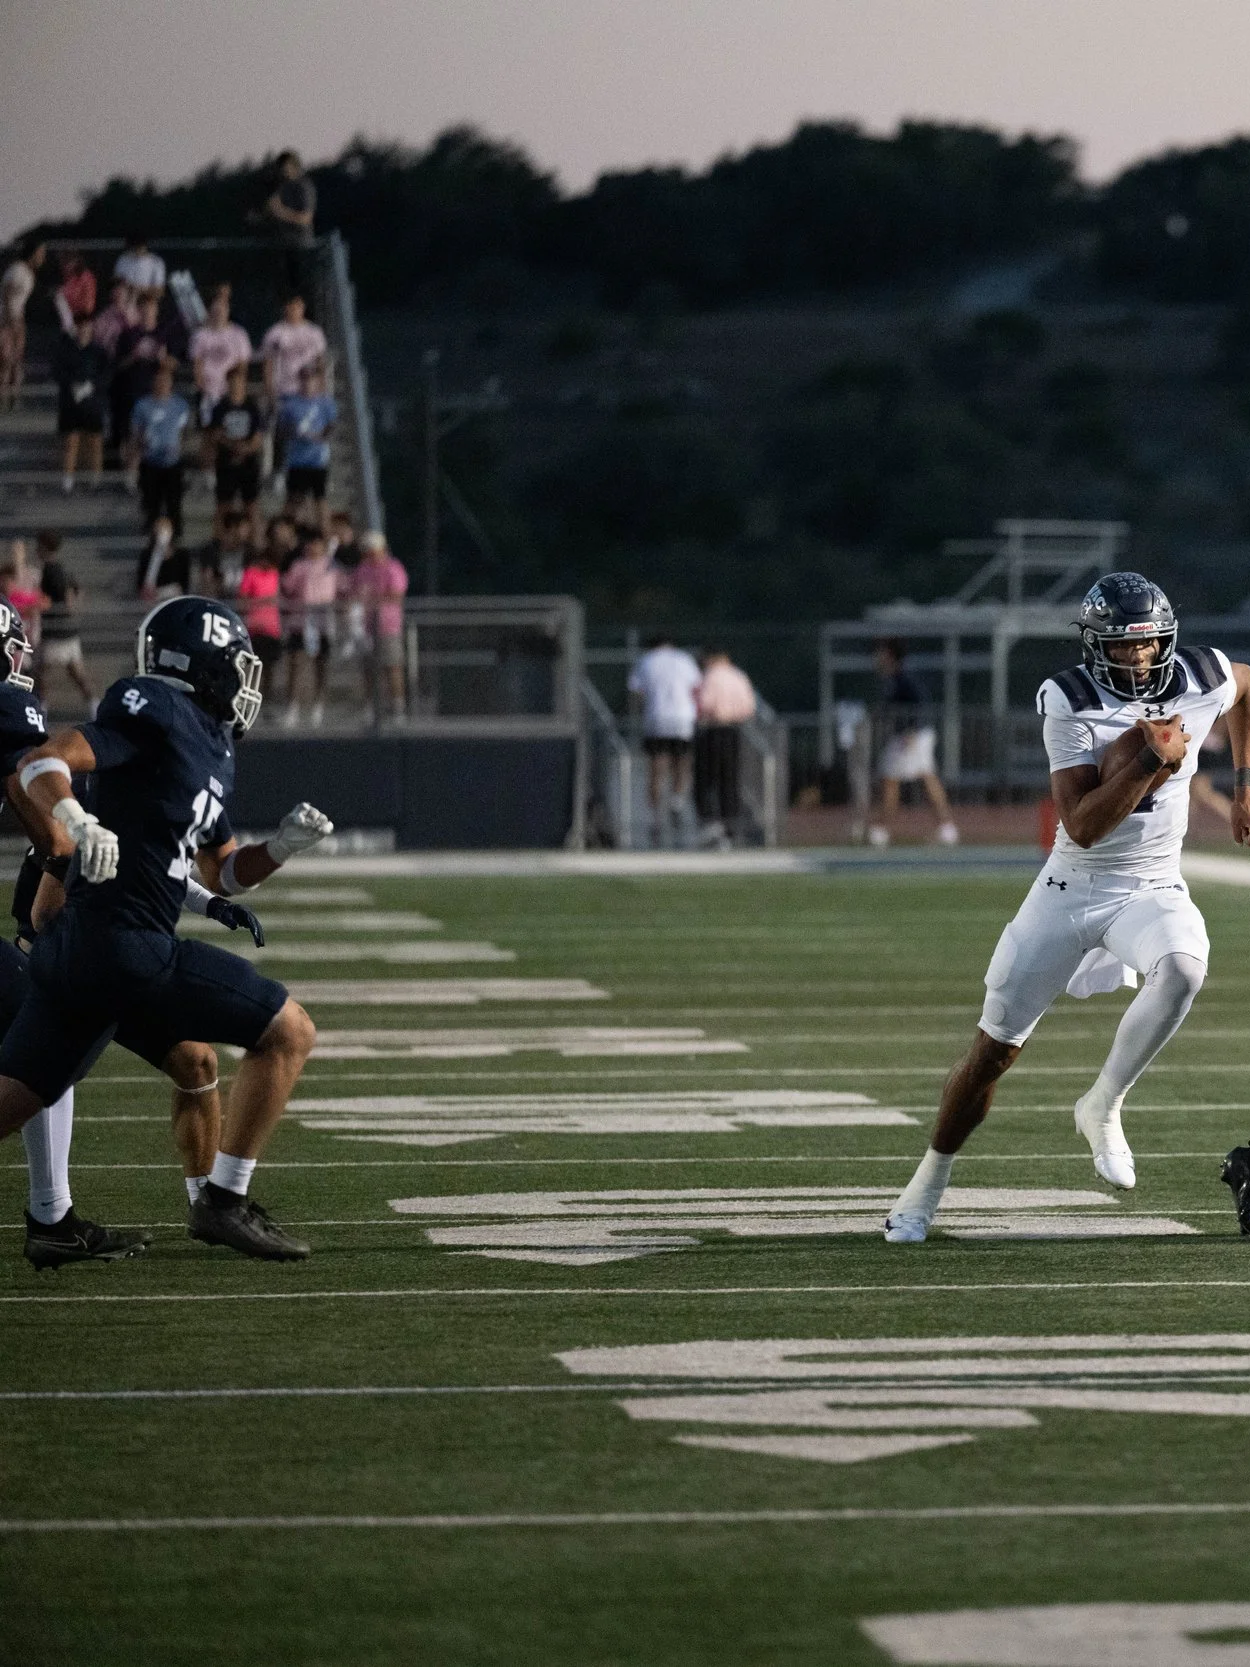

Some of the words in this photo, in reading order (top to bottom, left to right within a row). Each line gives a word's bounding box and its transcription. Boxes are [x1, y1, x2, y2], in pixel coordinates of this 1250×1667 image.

[202, 611, 231, 648] 15
[1129, 624, 1153, 632] Riddell
[121, 688, 149, 716] SV
[25, 706, 46, 733] SV
[387, 1186, 1204, 1247] 30
